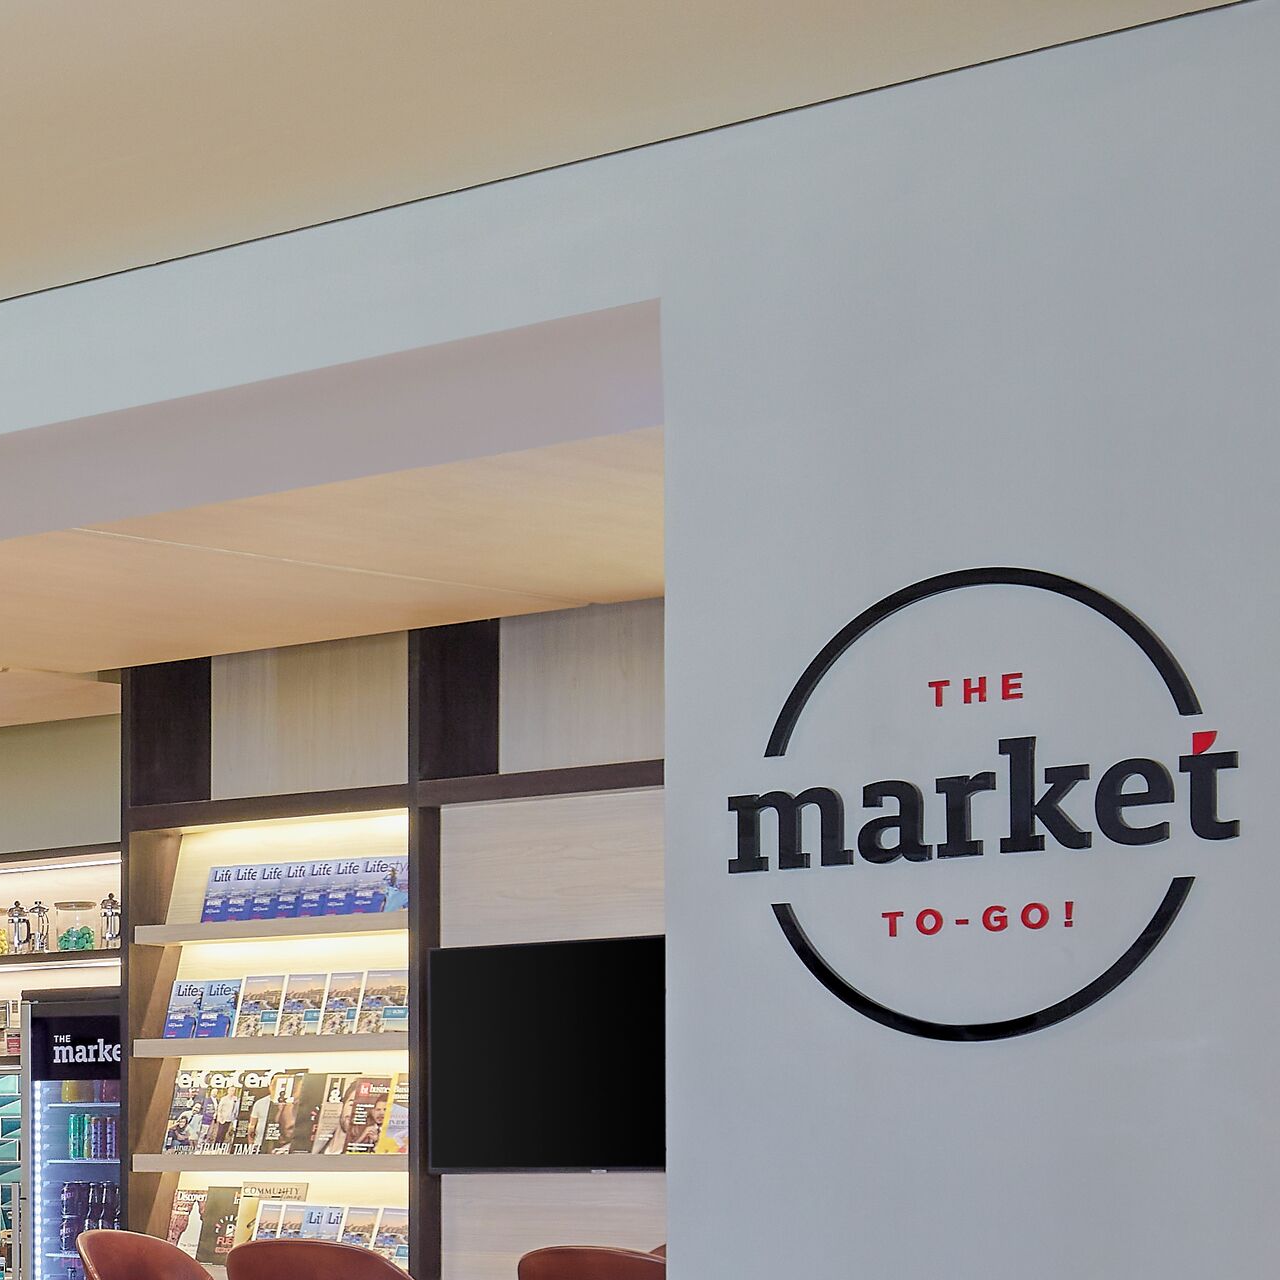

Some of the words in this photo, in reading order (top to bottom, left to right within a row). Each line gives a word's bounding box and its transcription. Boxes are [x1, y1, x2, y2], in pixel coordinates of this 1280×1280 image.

[928, 672, 1024, 708] THE
[727, 730, 1240, 875] market
[881, 901, 1075, 938] TO-GO!
[53, 1034, 71, 1043] THE
